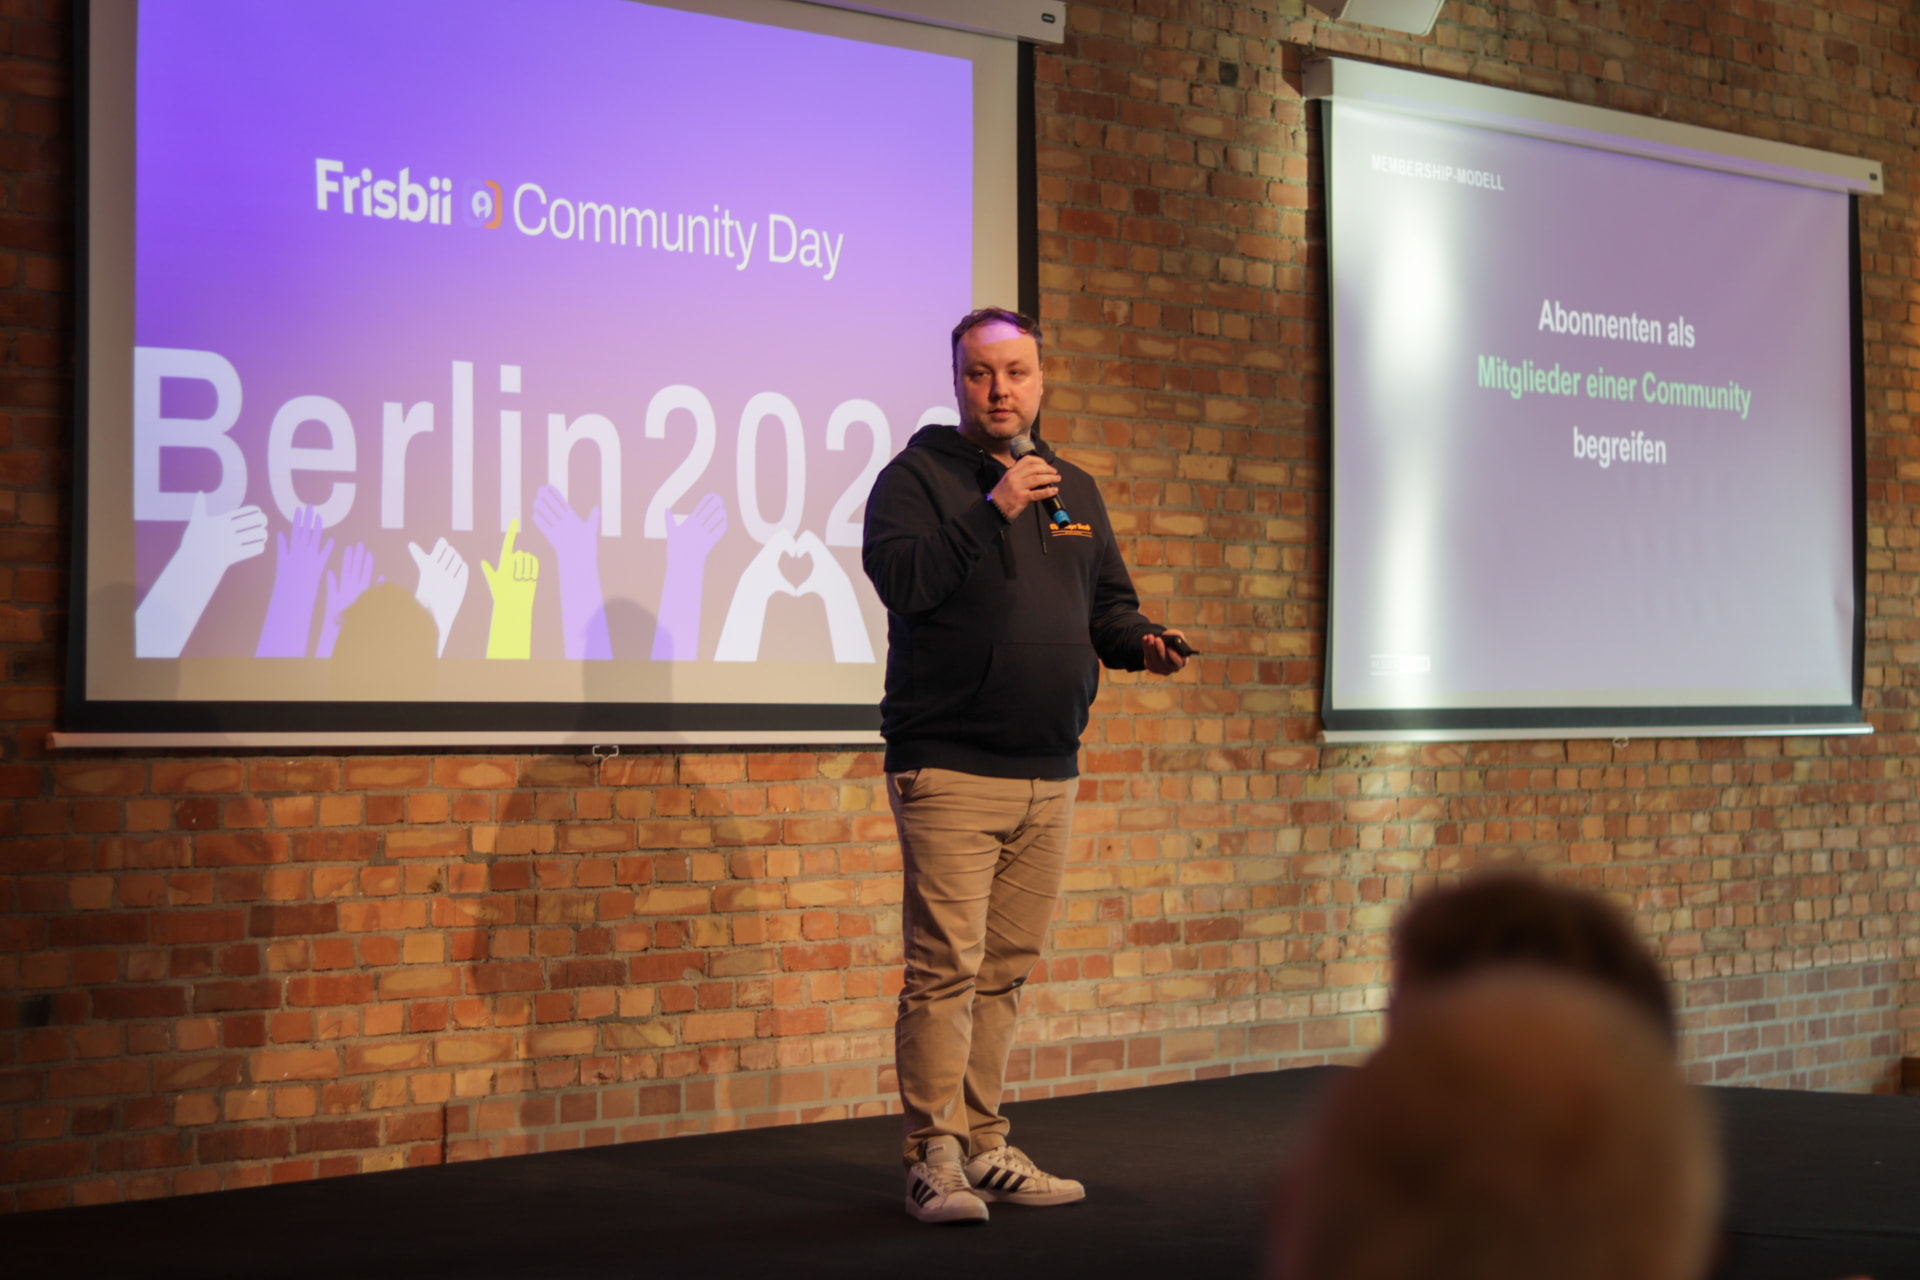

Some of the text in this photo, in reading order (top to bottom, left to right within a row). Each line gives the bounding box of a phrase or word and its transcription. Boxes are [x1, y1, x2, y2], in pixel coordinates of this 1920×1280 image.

[1370, 153, 1504, 191] MEMBERSHIP-MODELL
[315, 158, 844, 280] Frisbii Community Day
[1538, 299, 1696, 348] Abonnenten als
[1477, 354, 1752, 419] Mitglieder einer Community
[133, 346, 961, 546] Berlin202
[1572, 426, 1667, 468] begreifen
